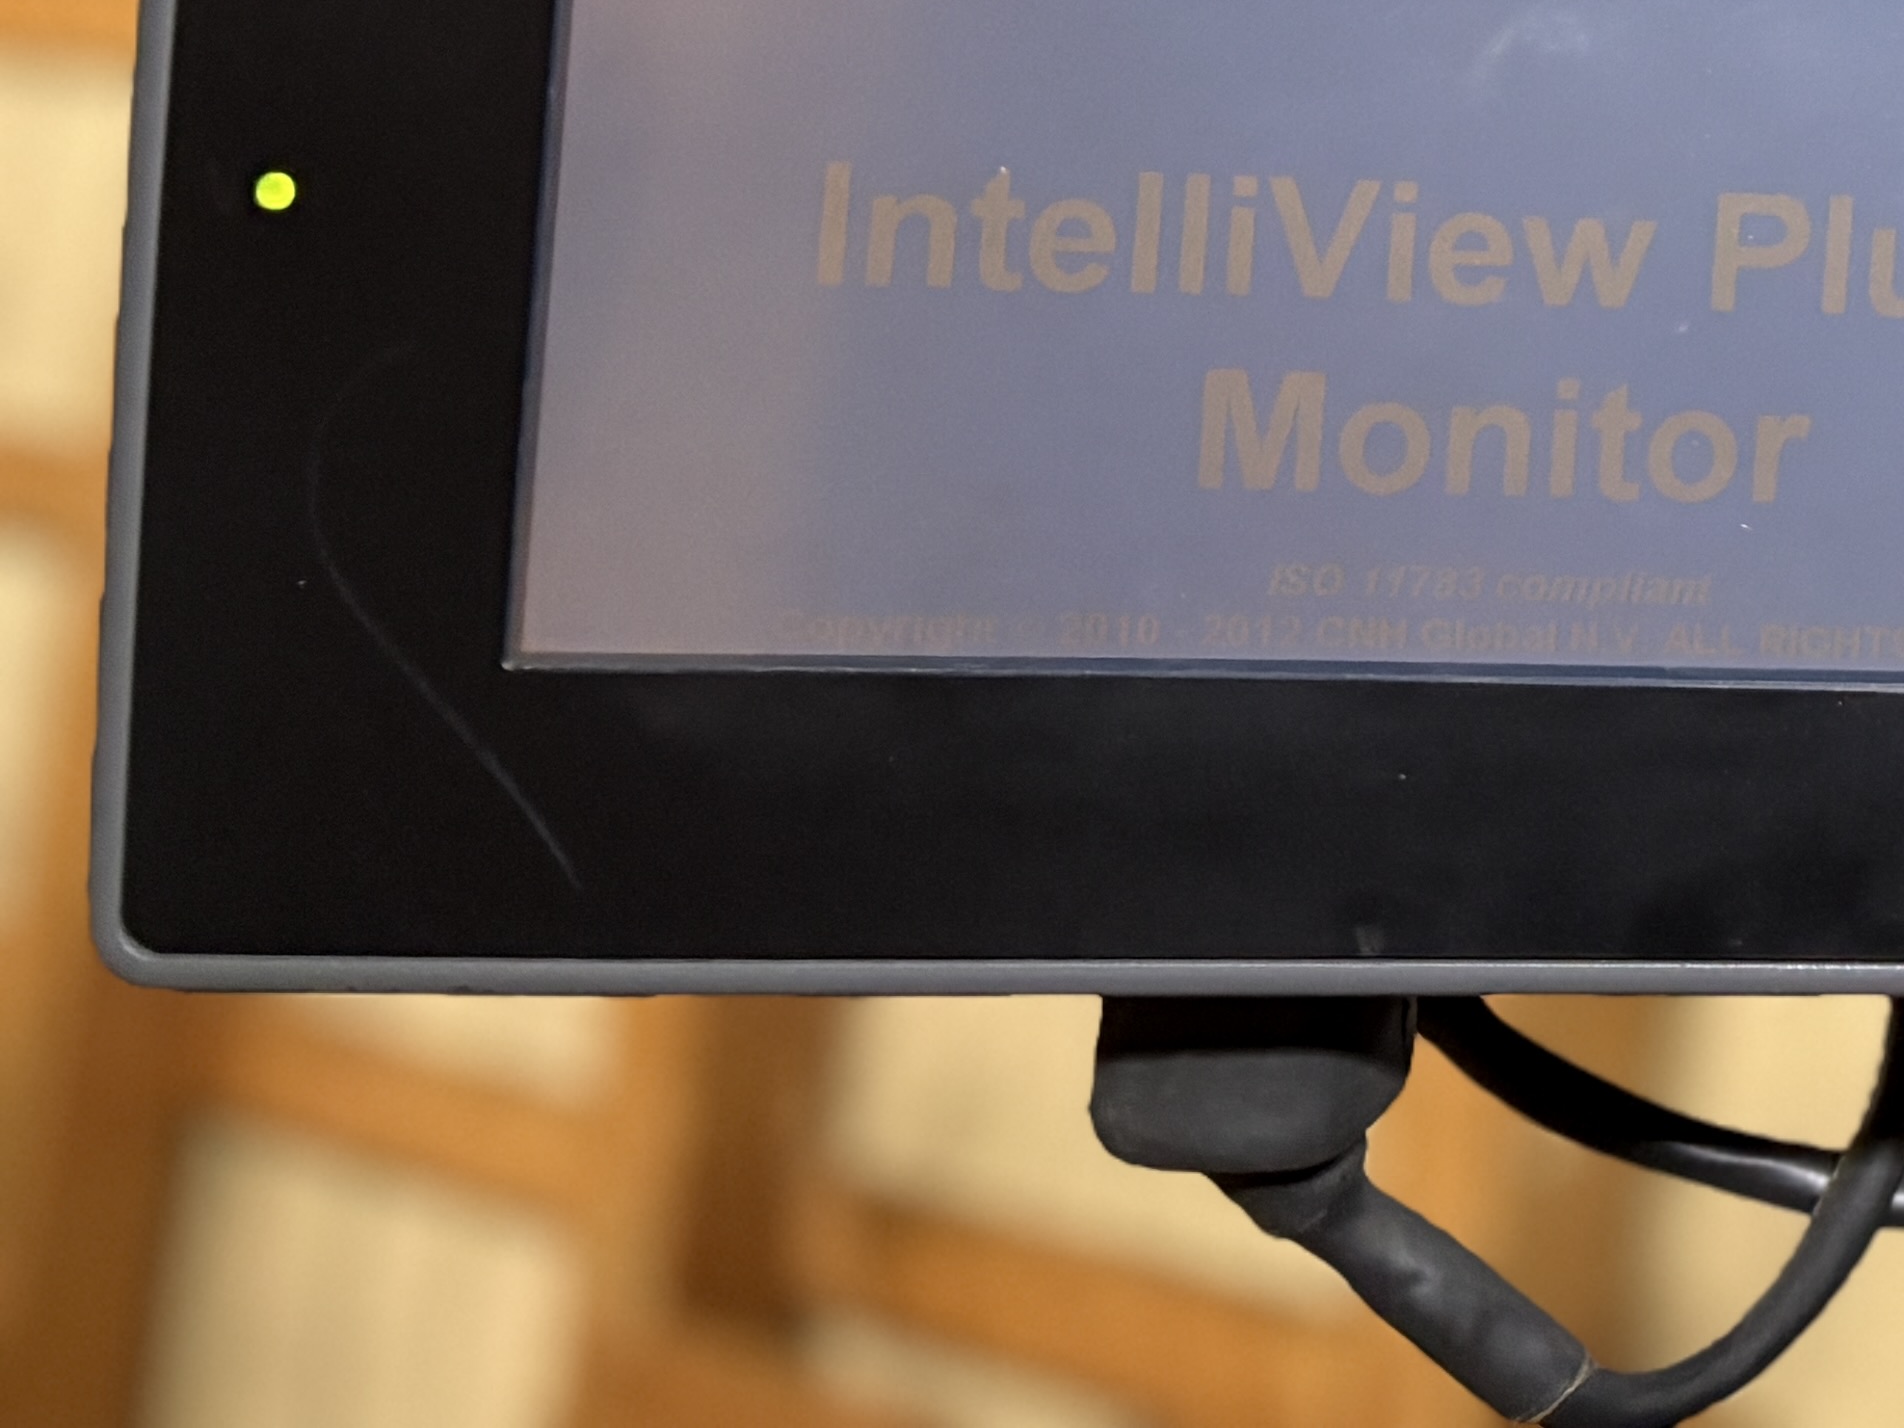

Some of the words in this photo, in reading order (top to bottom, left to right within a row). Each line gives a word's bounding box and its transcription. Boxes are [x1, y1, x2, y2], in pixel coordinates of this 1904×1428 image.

[815, 160, 1656, 308] IntelliView
[1199, 368, 1811, 504] Monitor
[1269, 562, 1345, 598] ISO
[1498, 571, 1714, 609] compliant
[1316, 615, 1408, 648] CNH
[1421, 616, 1558, 652] Global
[1665, 622, 1745, 656] ALL
